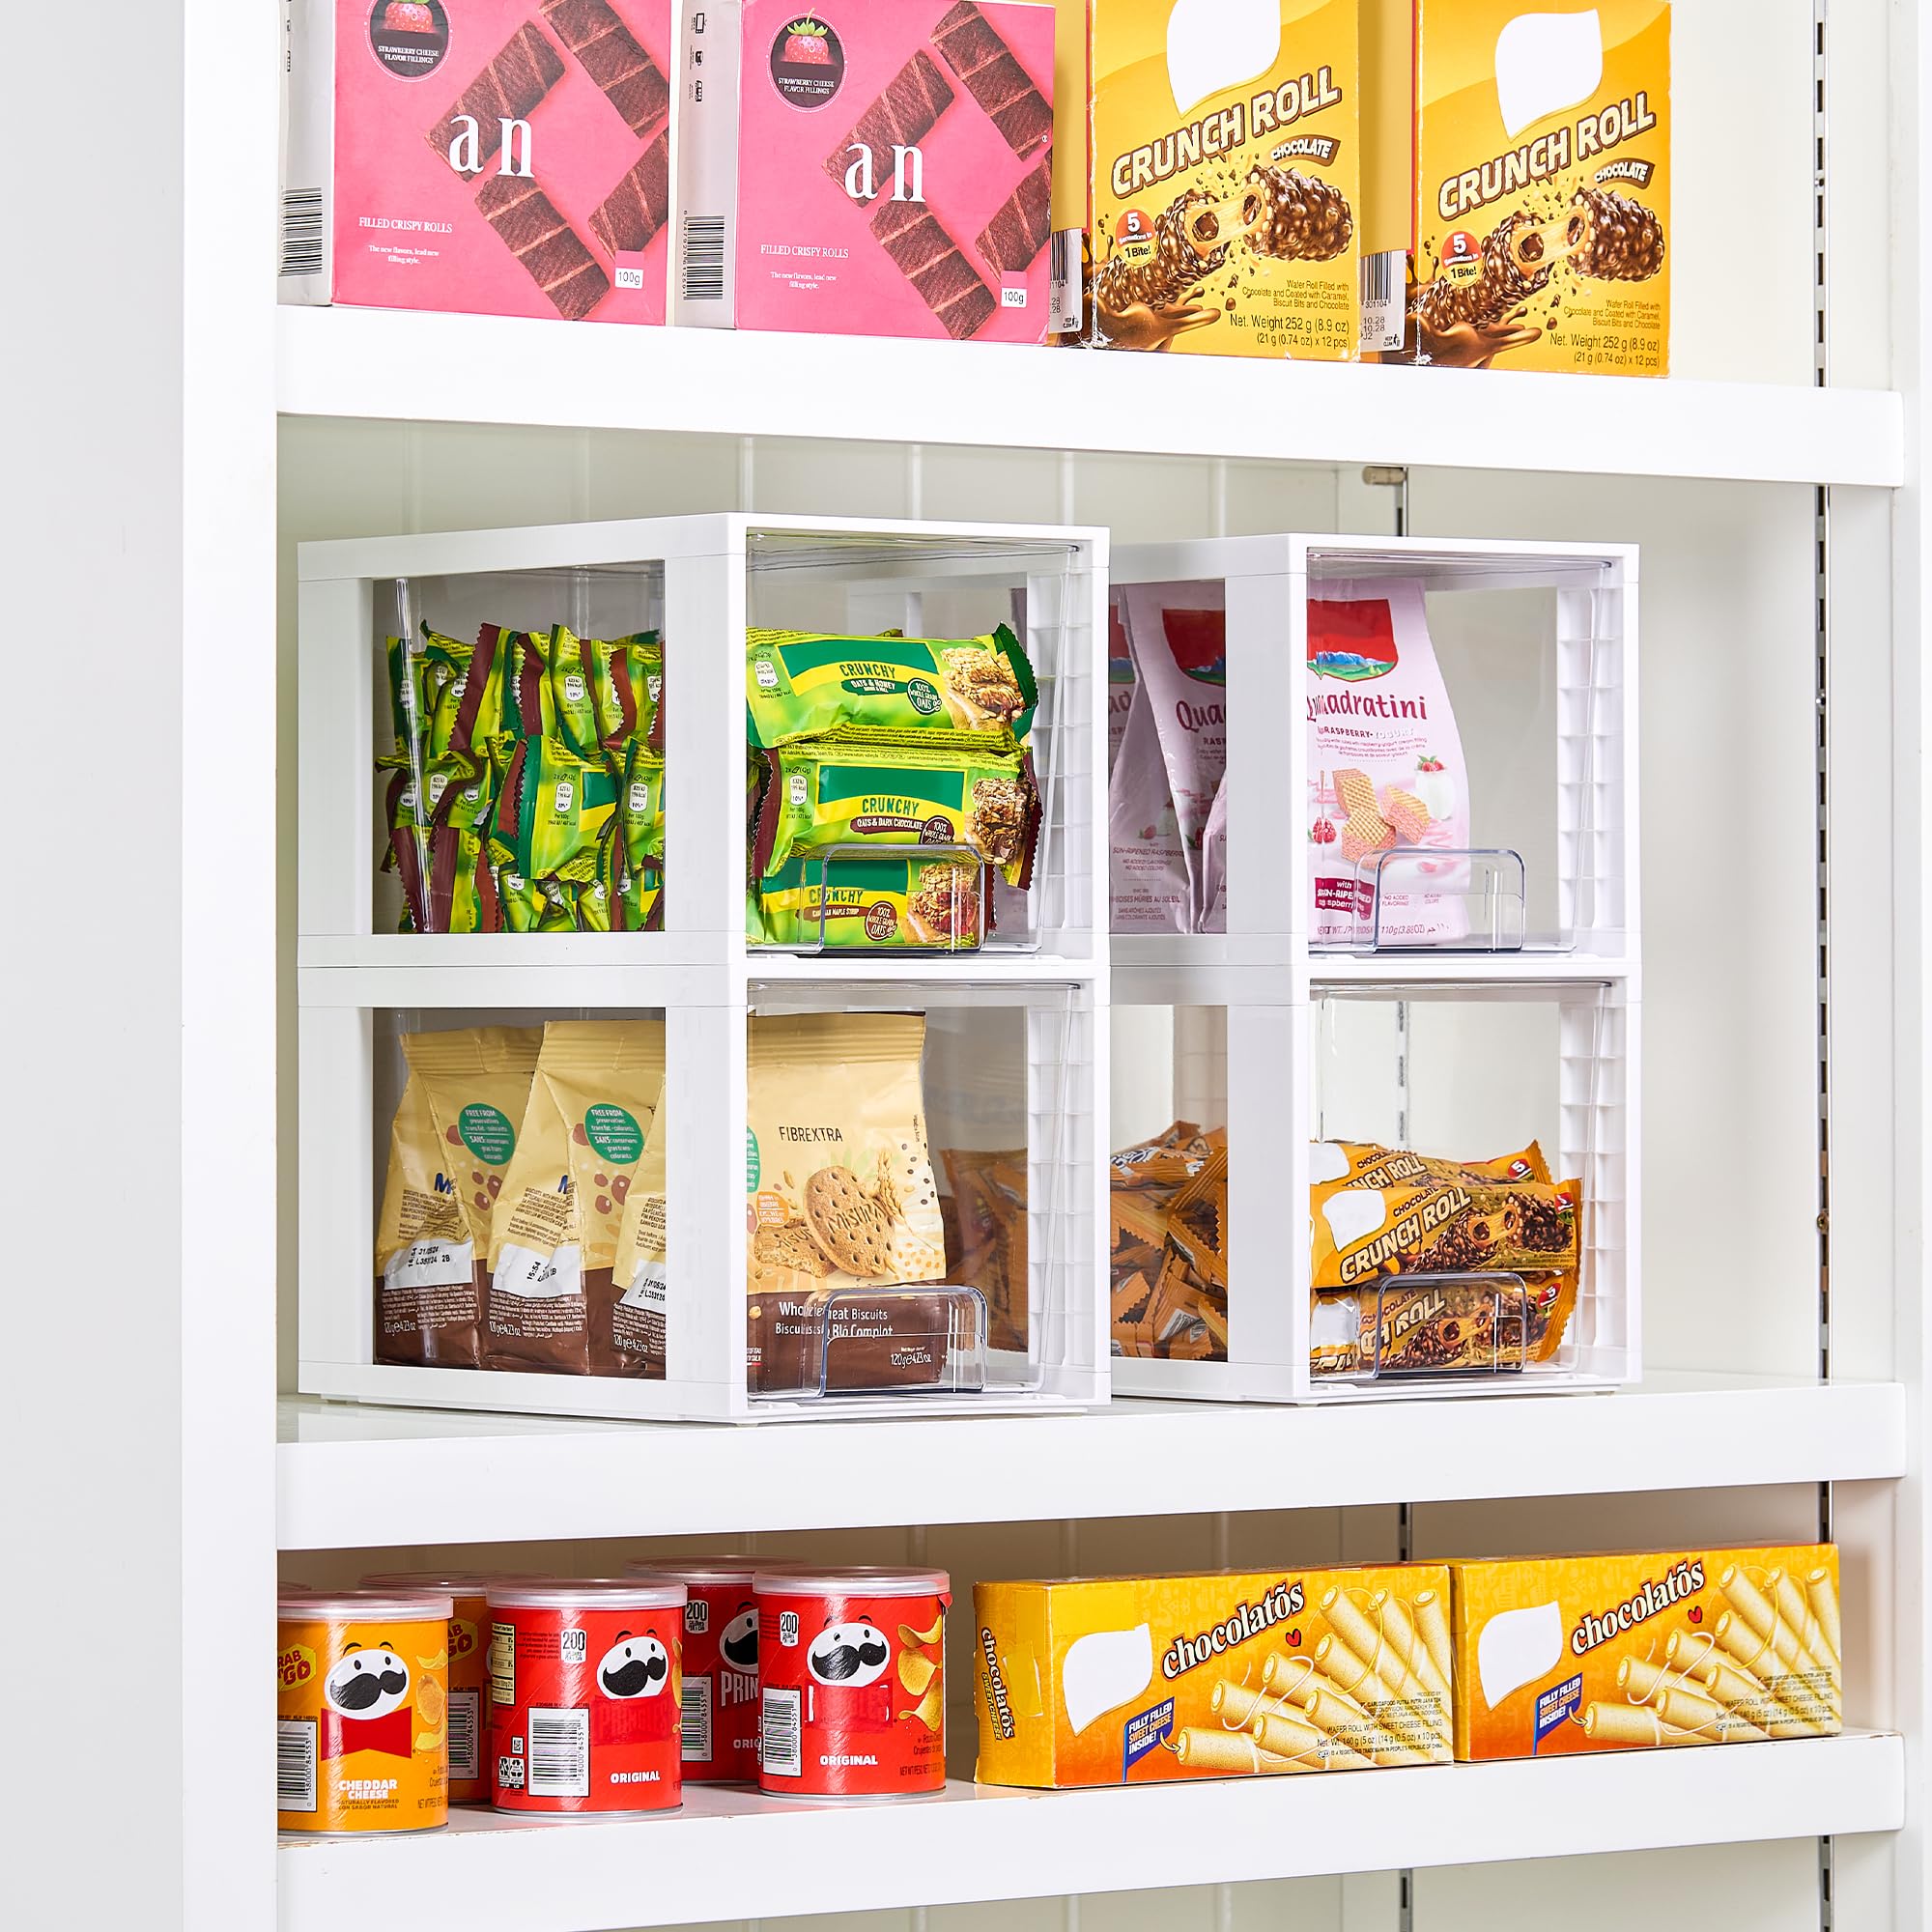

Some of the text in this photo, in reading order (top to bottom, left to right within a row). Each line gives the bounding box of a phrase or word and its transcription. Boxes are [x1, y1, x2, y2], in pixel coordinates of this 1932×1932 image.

[1114, 66, 1342, 197] CRUNCH ROLL
[1271, 138, 1334, 161] CHOCOLATE
[1438, 91, 1656, 220] CRUNCH ROLL
[1594, 160, 1650, 183] CHOCOLATE
[358, 216, 453, 234] FILLED CRISPY ROLLS
[1127, 213, 1141, 233] 5
[760, 243, 849, 259] FILLED CRISPY ROLLS
[1125, 244, 1151, 258] 1 Bite!
[1453, 234, 1466, 254] 5
[617, 270, 640, 288] 100g
[1451, 265, 1477, 278] 1 Bite!
[1242, 287, 1271, 298] Chocolate
[1272, 289, 1285, 298] and
[1285, 289, 1307, 298] Coated
[1308, 290, 1321, 299] with
[1306, 280, 1318, 290] Roll
[1320, 281, 1335, 291] Filled
[1337, 282, 1350, 291] with
[1003, 291, 1025, 305] 100g
[1273, 298, 1350, 311] Biscuit Bits and Chocolate
[1230, 314, 1350, 335] Net. Weight 252 g (8.9 oz)
[1258, 332, 1350, 350] (21 g (0.74 oz) x 12 pcs)
[1549, 332, 1660, 354] Net. Weight 252 g (8.9 oz)
[1575, 352, 1660, 367] (21 g (0.74 oz) x 12 pcs)
[839, 663, 895, 679] CRUNCHY
[851, 679, 867, 688] OATS
[916, 697, 932, 709] OATS
[1176, 699, 1226, 733] Qua
[862, 797, 920, 816] CRUNCHY
[857, 817, 923, 831] OATS & DARK CHOCOLATE
[871, 923, 887, 935] OATS
[779, 1126, 843, 1143] FIBREXTRA
[1385, 1155, 1428, 1179] ROLL
[1513, 1159, 1526, 1174] 5
[1341, 1186, 1472, 1284] CRUNCH ROLL
[442, 1254, 450, 1263] 2B
[526, 1262, 541, 1281] 15:54
[1546, 1287, 1556, 1299] 5
[852, 1308, 888, 1321] Biscuits
[1395, 1289, 1446, 1339] ROLL
[686, 1602, 708, 1622] 200
[781, 1613, 798, 1634] 200
[562, 1632, 585, 1651] 200
[721, 1670, 759, 1707] PRIN
[1540, 1677, 1580, 1709] FULLY FILLED
[981, 1672, 1003, 1741] SWEET CHEESE
[1128, 1702, 1173, 1734] FULLY FILLED
[1128, 1712, 1172, 1745] SWEET CHEESE
[1349, 1724, 1362, 1733] ROLL
[1128, 1731, 1157, 1754] INSIDE!
[819, 1755, 879, 1766] ORIGINAL
[338, 1778, 398, 1791] CHEDDAR
[611, 1770, 661, 1784] ORIGINAL
[348, 1789, 389, 1800] CHEESE
